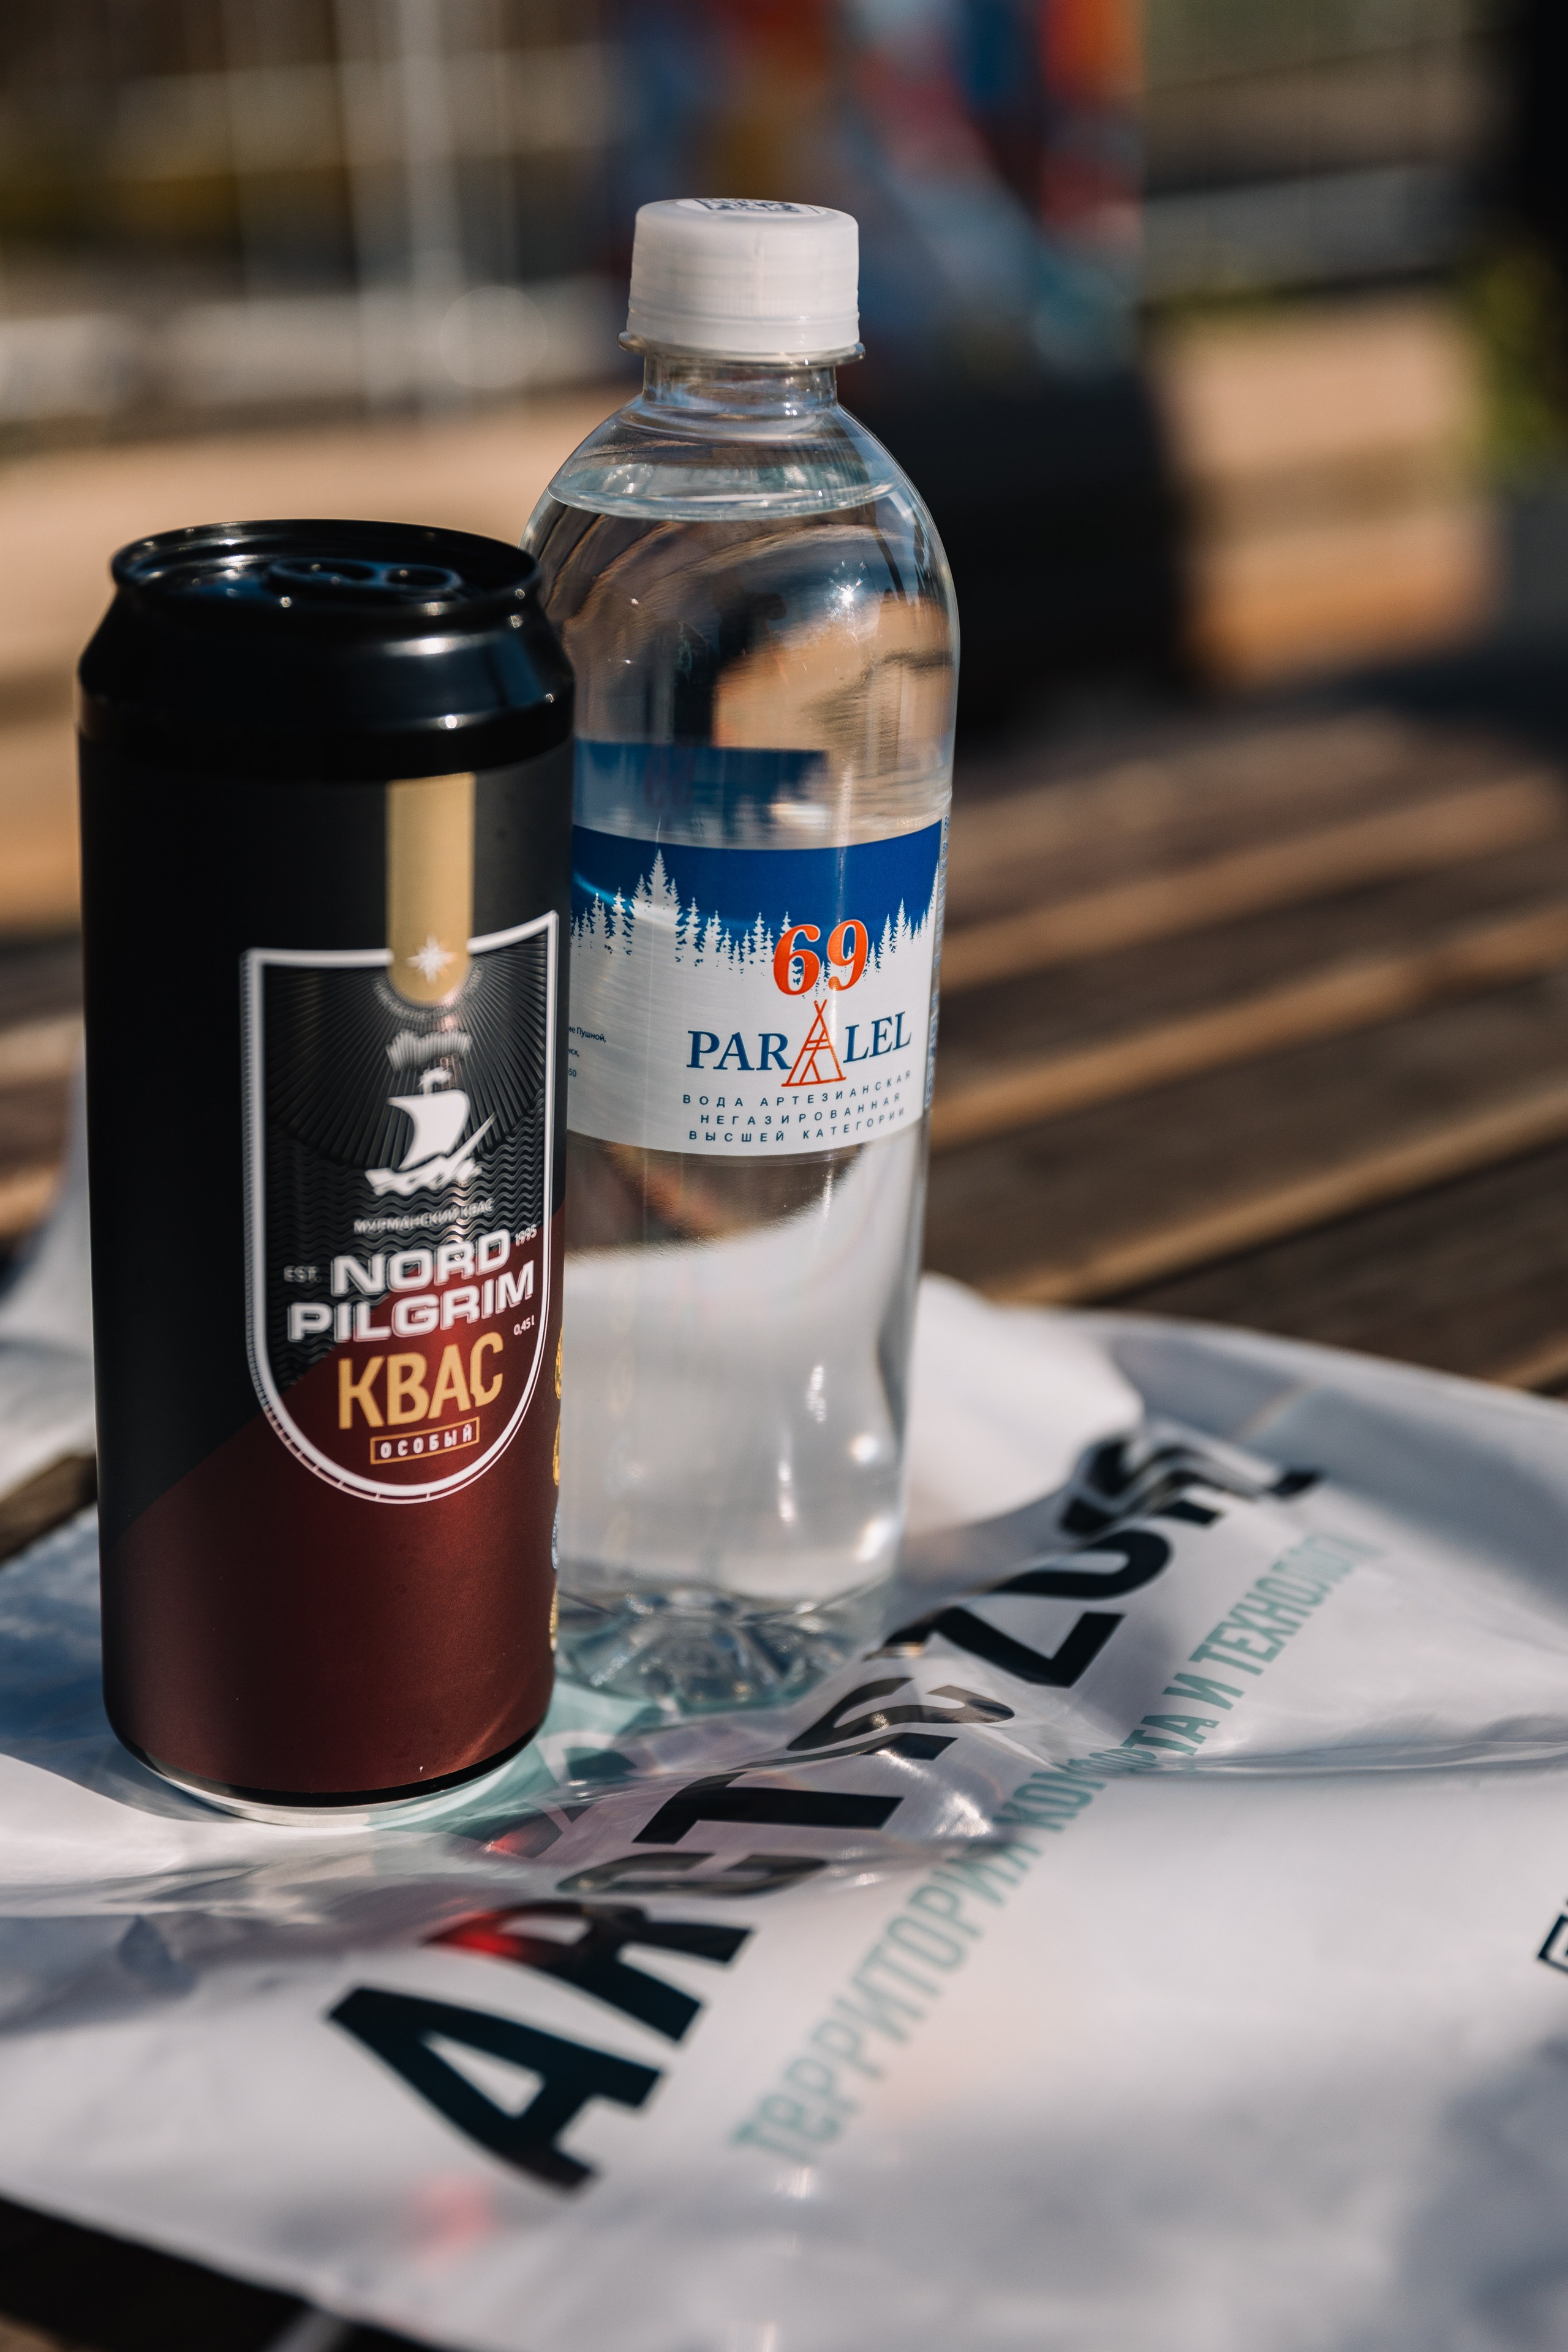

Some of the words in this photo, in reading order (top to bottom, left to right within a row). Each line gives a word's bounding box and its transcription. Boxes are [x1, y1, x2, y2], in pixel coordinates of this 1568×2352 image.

[772, 919, 869, 995] 69
[576, 1027, 606, 1043] Пушной,
[683, 1094, 744, 1107] ВОДА
[760, 1069, 911, 1107] АРТЕЗИАНСКАЯ
[689, 1130, 784, 1143] ВЫСШЕЙ
[802, 1107, 904, 1139] КАТЕГОРИИ
[700, 1092, 900, 1126] НЕГАЗИРОВАННАЯ
[514, 1223, 538, 1246] 1995
[331, 1228, 511, 1297] NORD
[287, 1259, 534, 1343] PILGRIM
[338, 1331, 503, 1430] КВАС
[380, 1423, 472, 1459] ОСОБЫЙ
[1162, 1672, 1246, 1711] И
